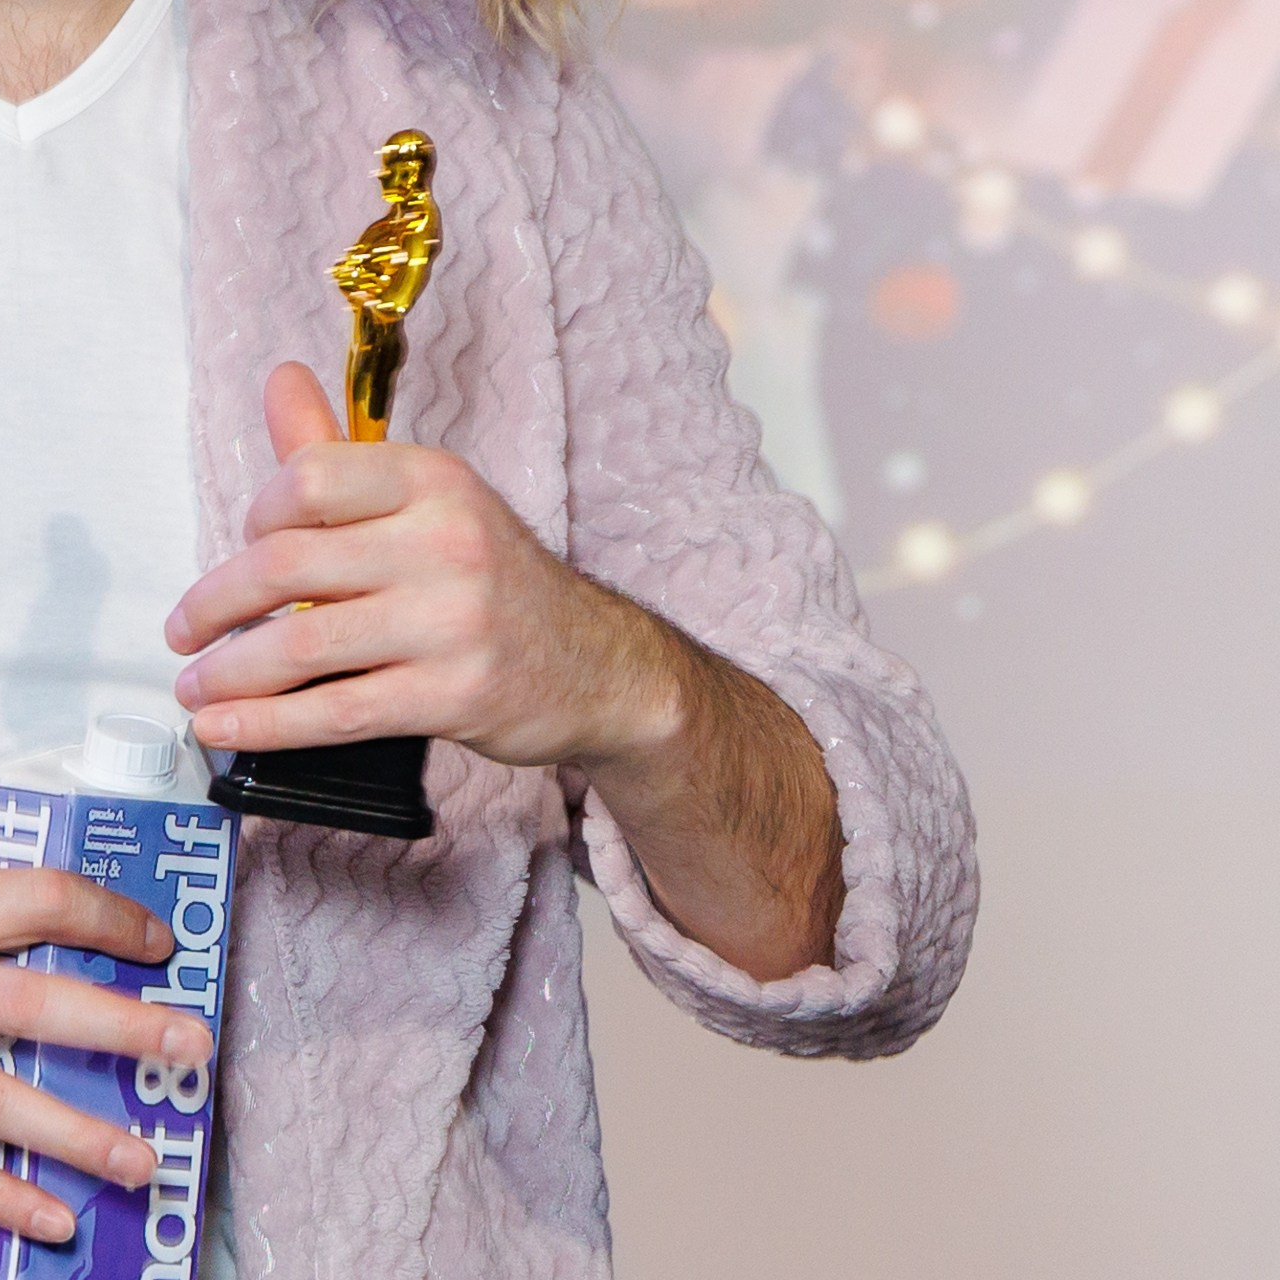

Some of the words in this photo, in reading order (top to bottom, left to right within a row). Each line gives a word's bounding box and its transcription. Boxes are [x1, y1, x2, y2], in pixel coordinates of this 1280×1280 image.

[81, 856, 109, 877] half
[108, 859, 121, 879] &
[140, 813, 232, 1017] half
